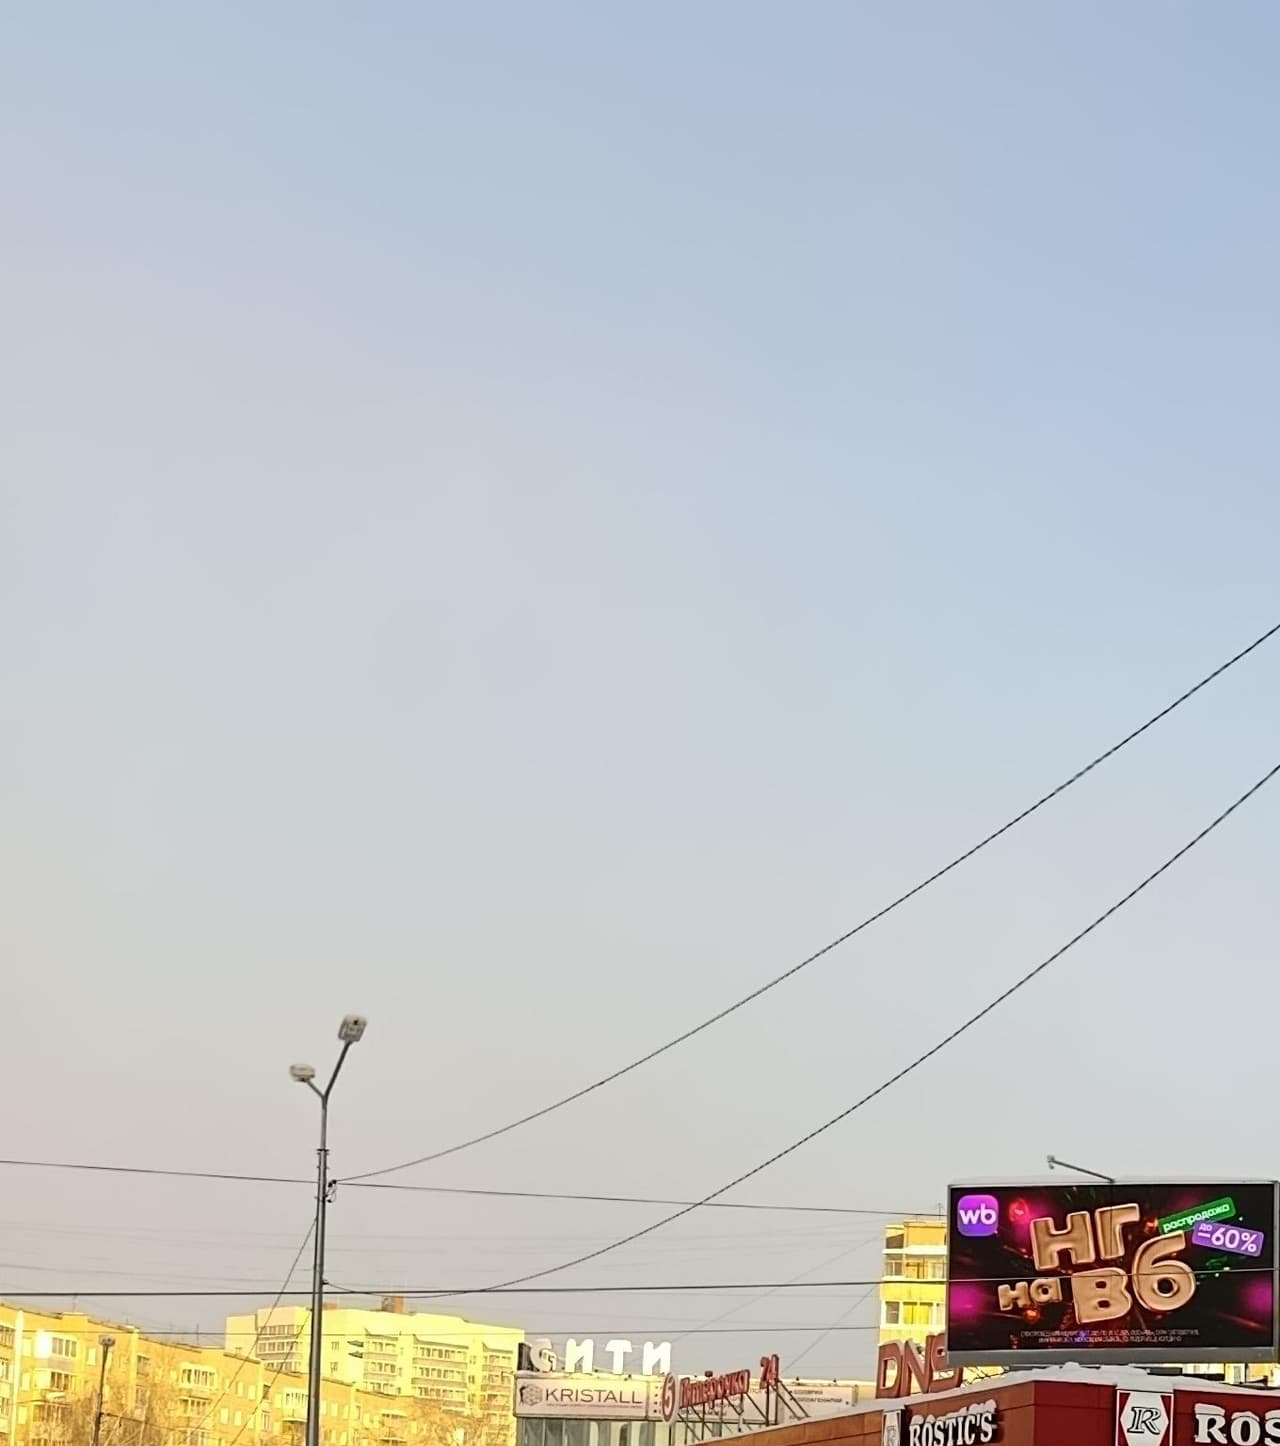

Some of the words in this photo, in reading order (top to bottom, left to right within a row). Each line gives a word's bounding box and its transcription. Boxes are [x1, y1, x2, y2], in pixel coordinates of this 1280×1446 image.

[1161, 1203, 1231, 1233] распродажа
[876, 1333, 963, 1398] DNS
[546, 1388, 643, 1404] KRISTALL
